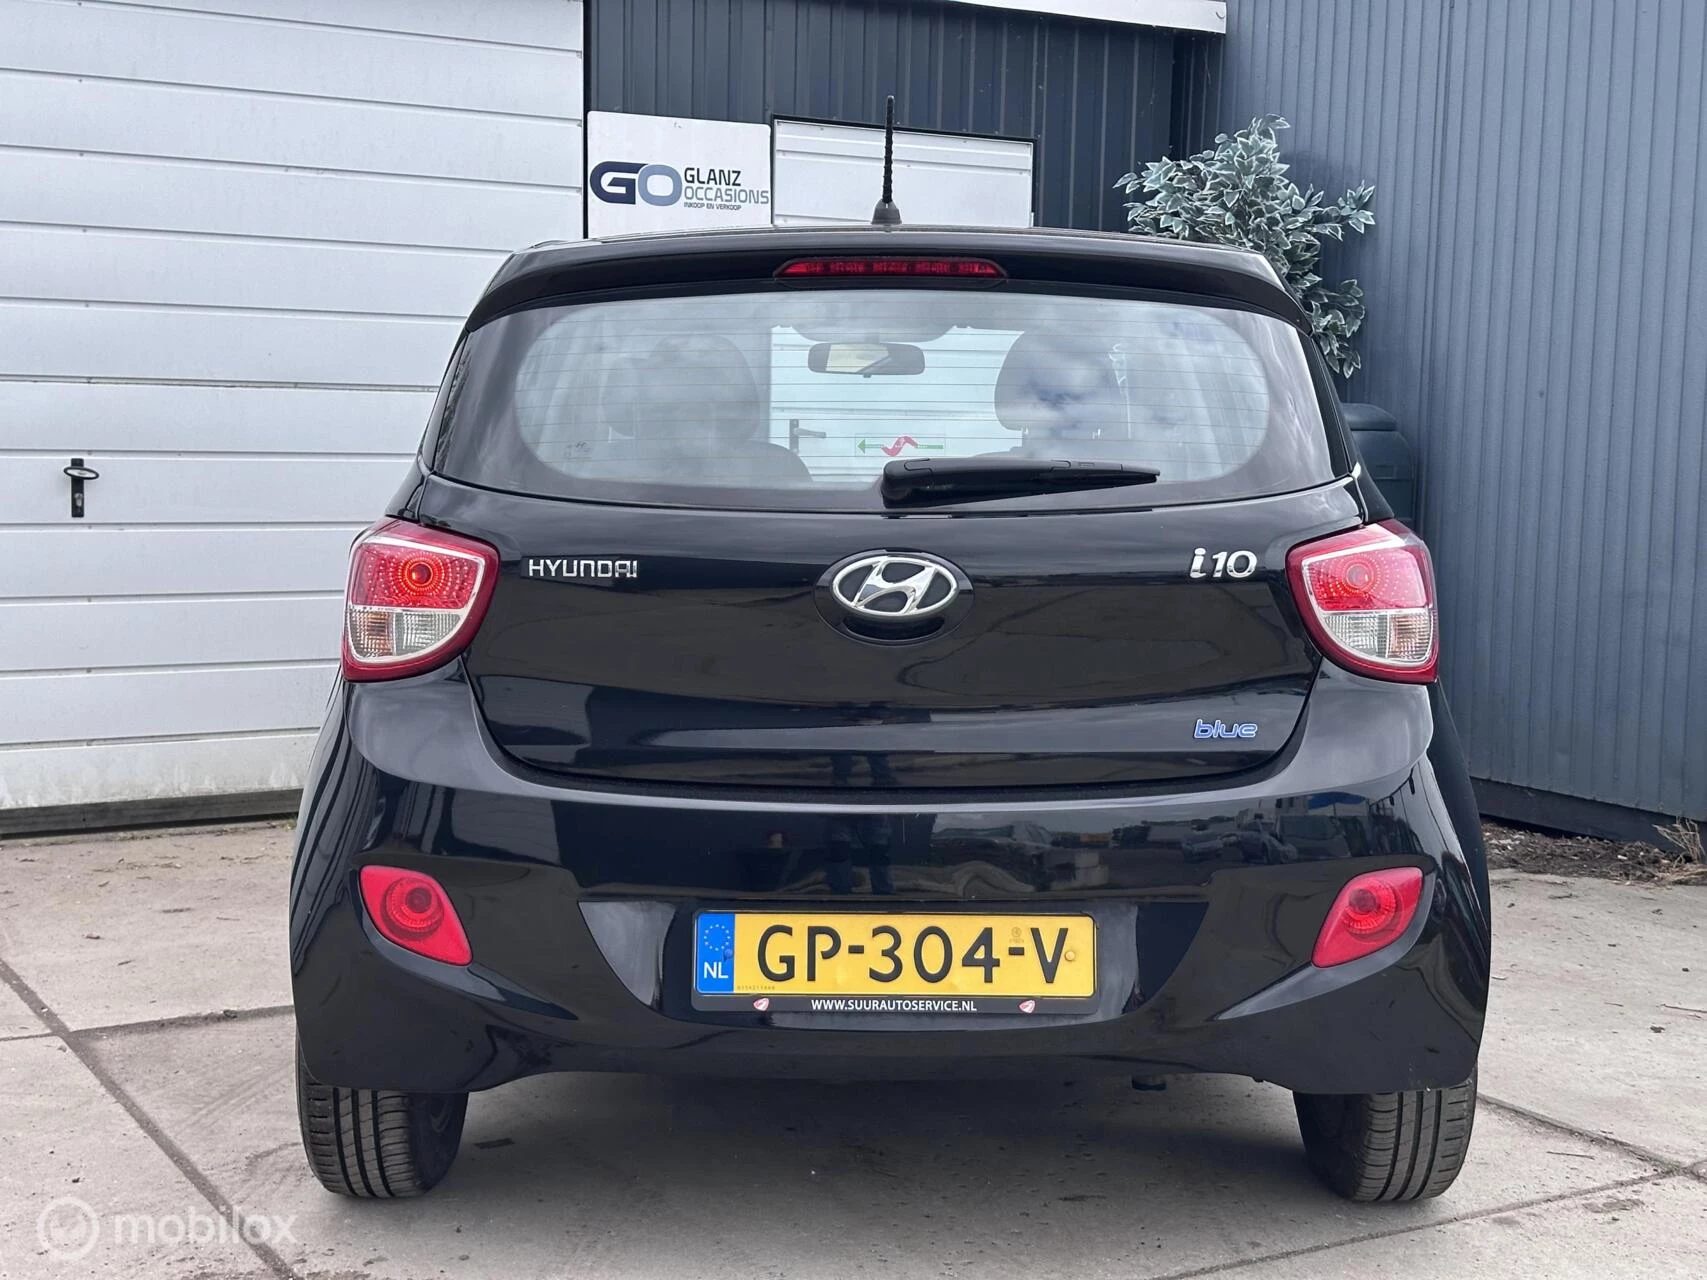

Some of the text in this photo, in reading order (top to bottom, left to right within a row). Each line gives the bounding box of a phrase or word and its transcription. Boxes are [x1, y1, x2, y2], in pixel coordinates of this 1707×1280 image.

[589, 160, 683, 207] GO
[684, 167, 741, 186] GLANZ
[684, 186, 769, 204] OCCASIONS
[528, 559, 638, 578] HYUNDAI
[1189, 547, 1258, 579] i10
[1193, 718, 1259, 740] blue
[757, 924, 1069, 984] GP-304-V
[703, 961, 729, 980] NL
[811, 998, 977, 1012] WWW.SUURAUTOSERVICE.NL
